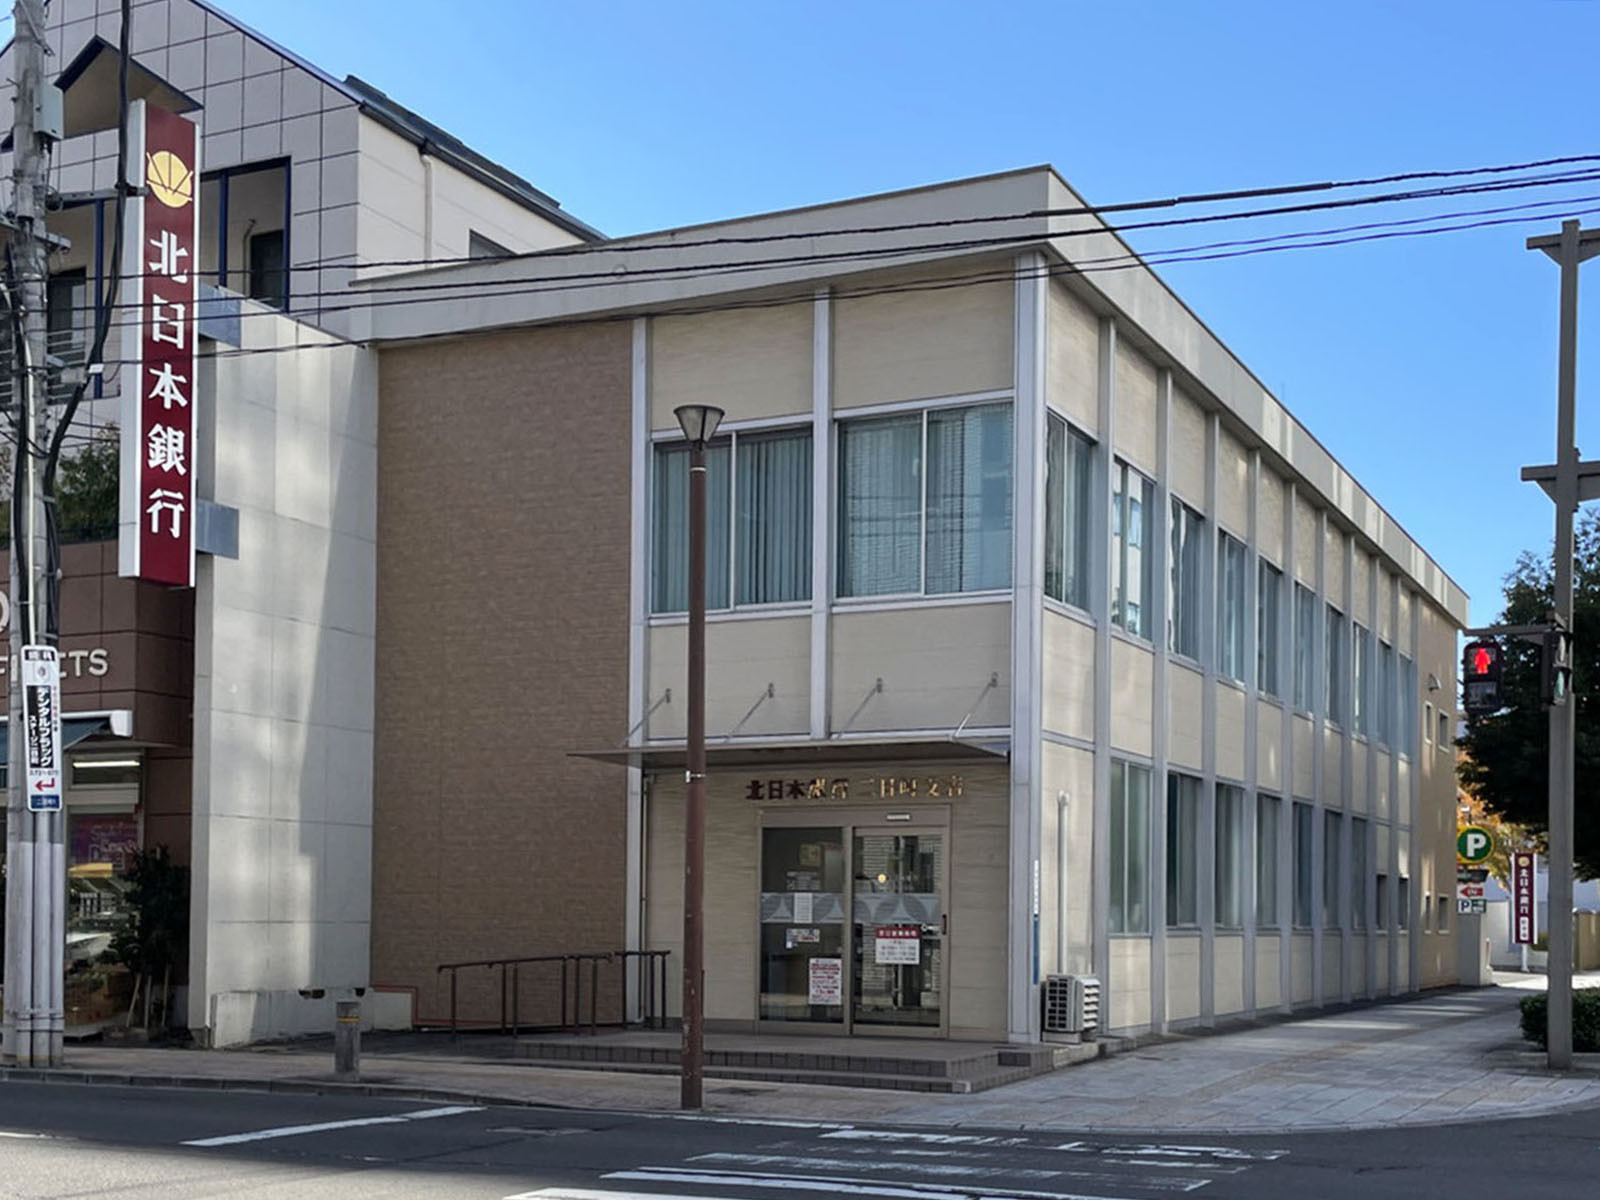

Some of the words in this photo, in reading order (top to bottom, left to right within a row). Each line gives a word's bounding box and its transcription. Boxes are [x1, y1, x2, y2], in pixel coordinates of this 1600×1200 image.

[146, 229, 189, 539] 北日本銀行
[1466, 833, 1487, 857] P
[1461, 900, 1470, 912] P
